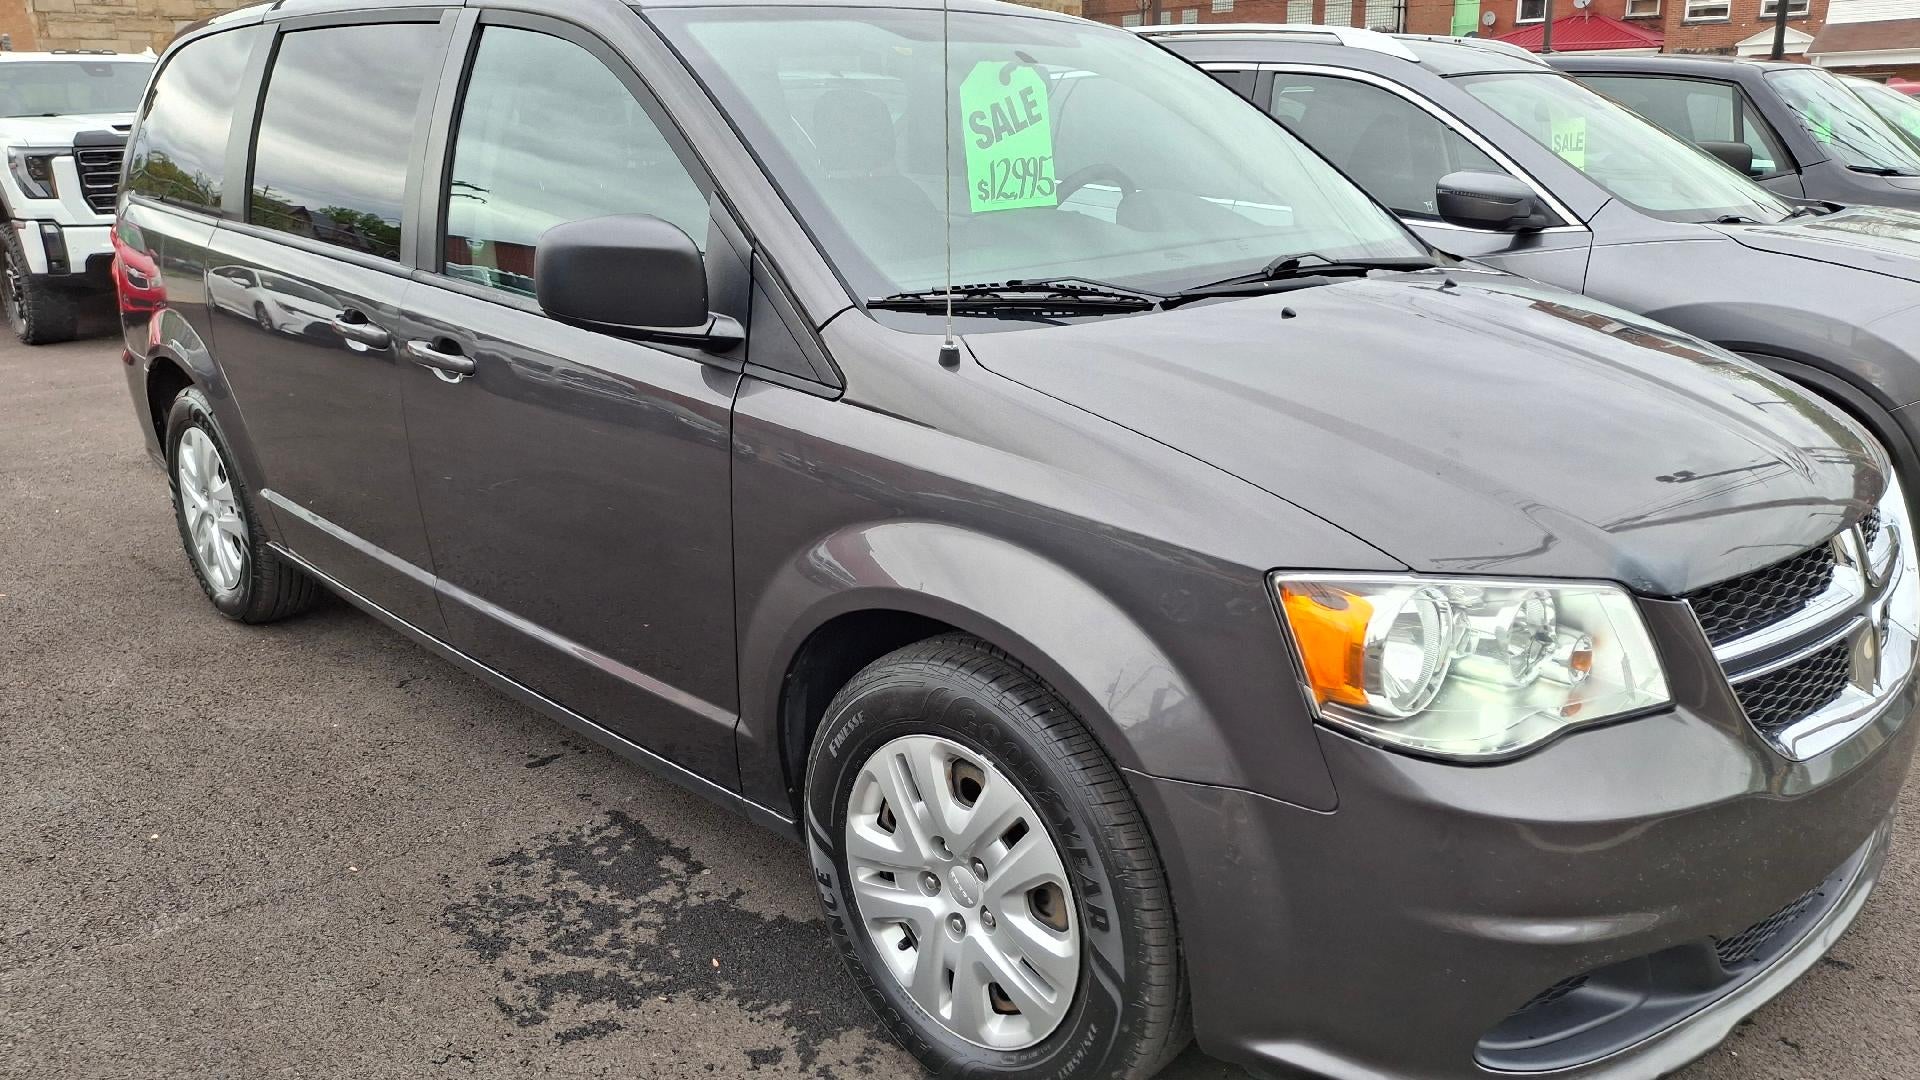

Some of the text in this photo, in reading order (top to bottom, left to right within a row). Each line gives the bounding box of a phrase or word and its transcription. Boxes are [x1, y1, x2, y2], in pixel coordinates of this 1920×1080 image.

[969, 86, 1042, 149] SALE
[1554, 131, 1584, 152] SALE
[828, 710, 865, 758] FINESSE
